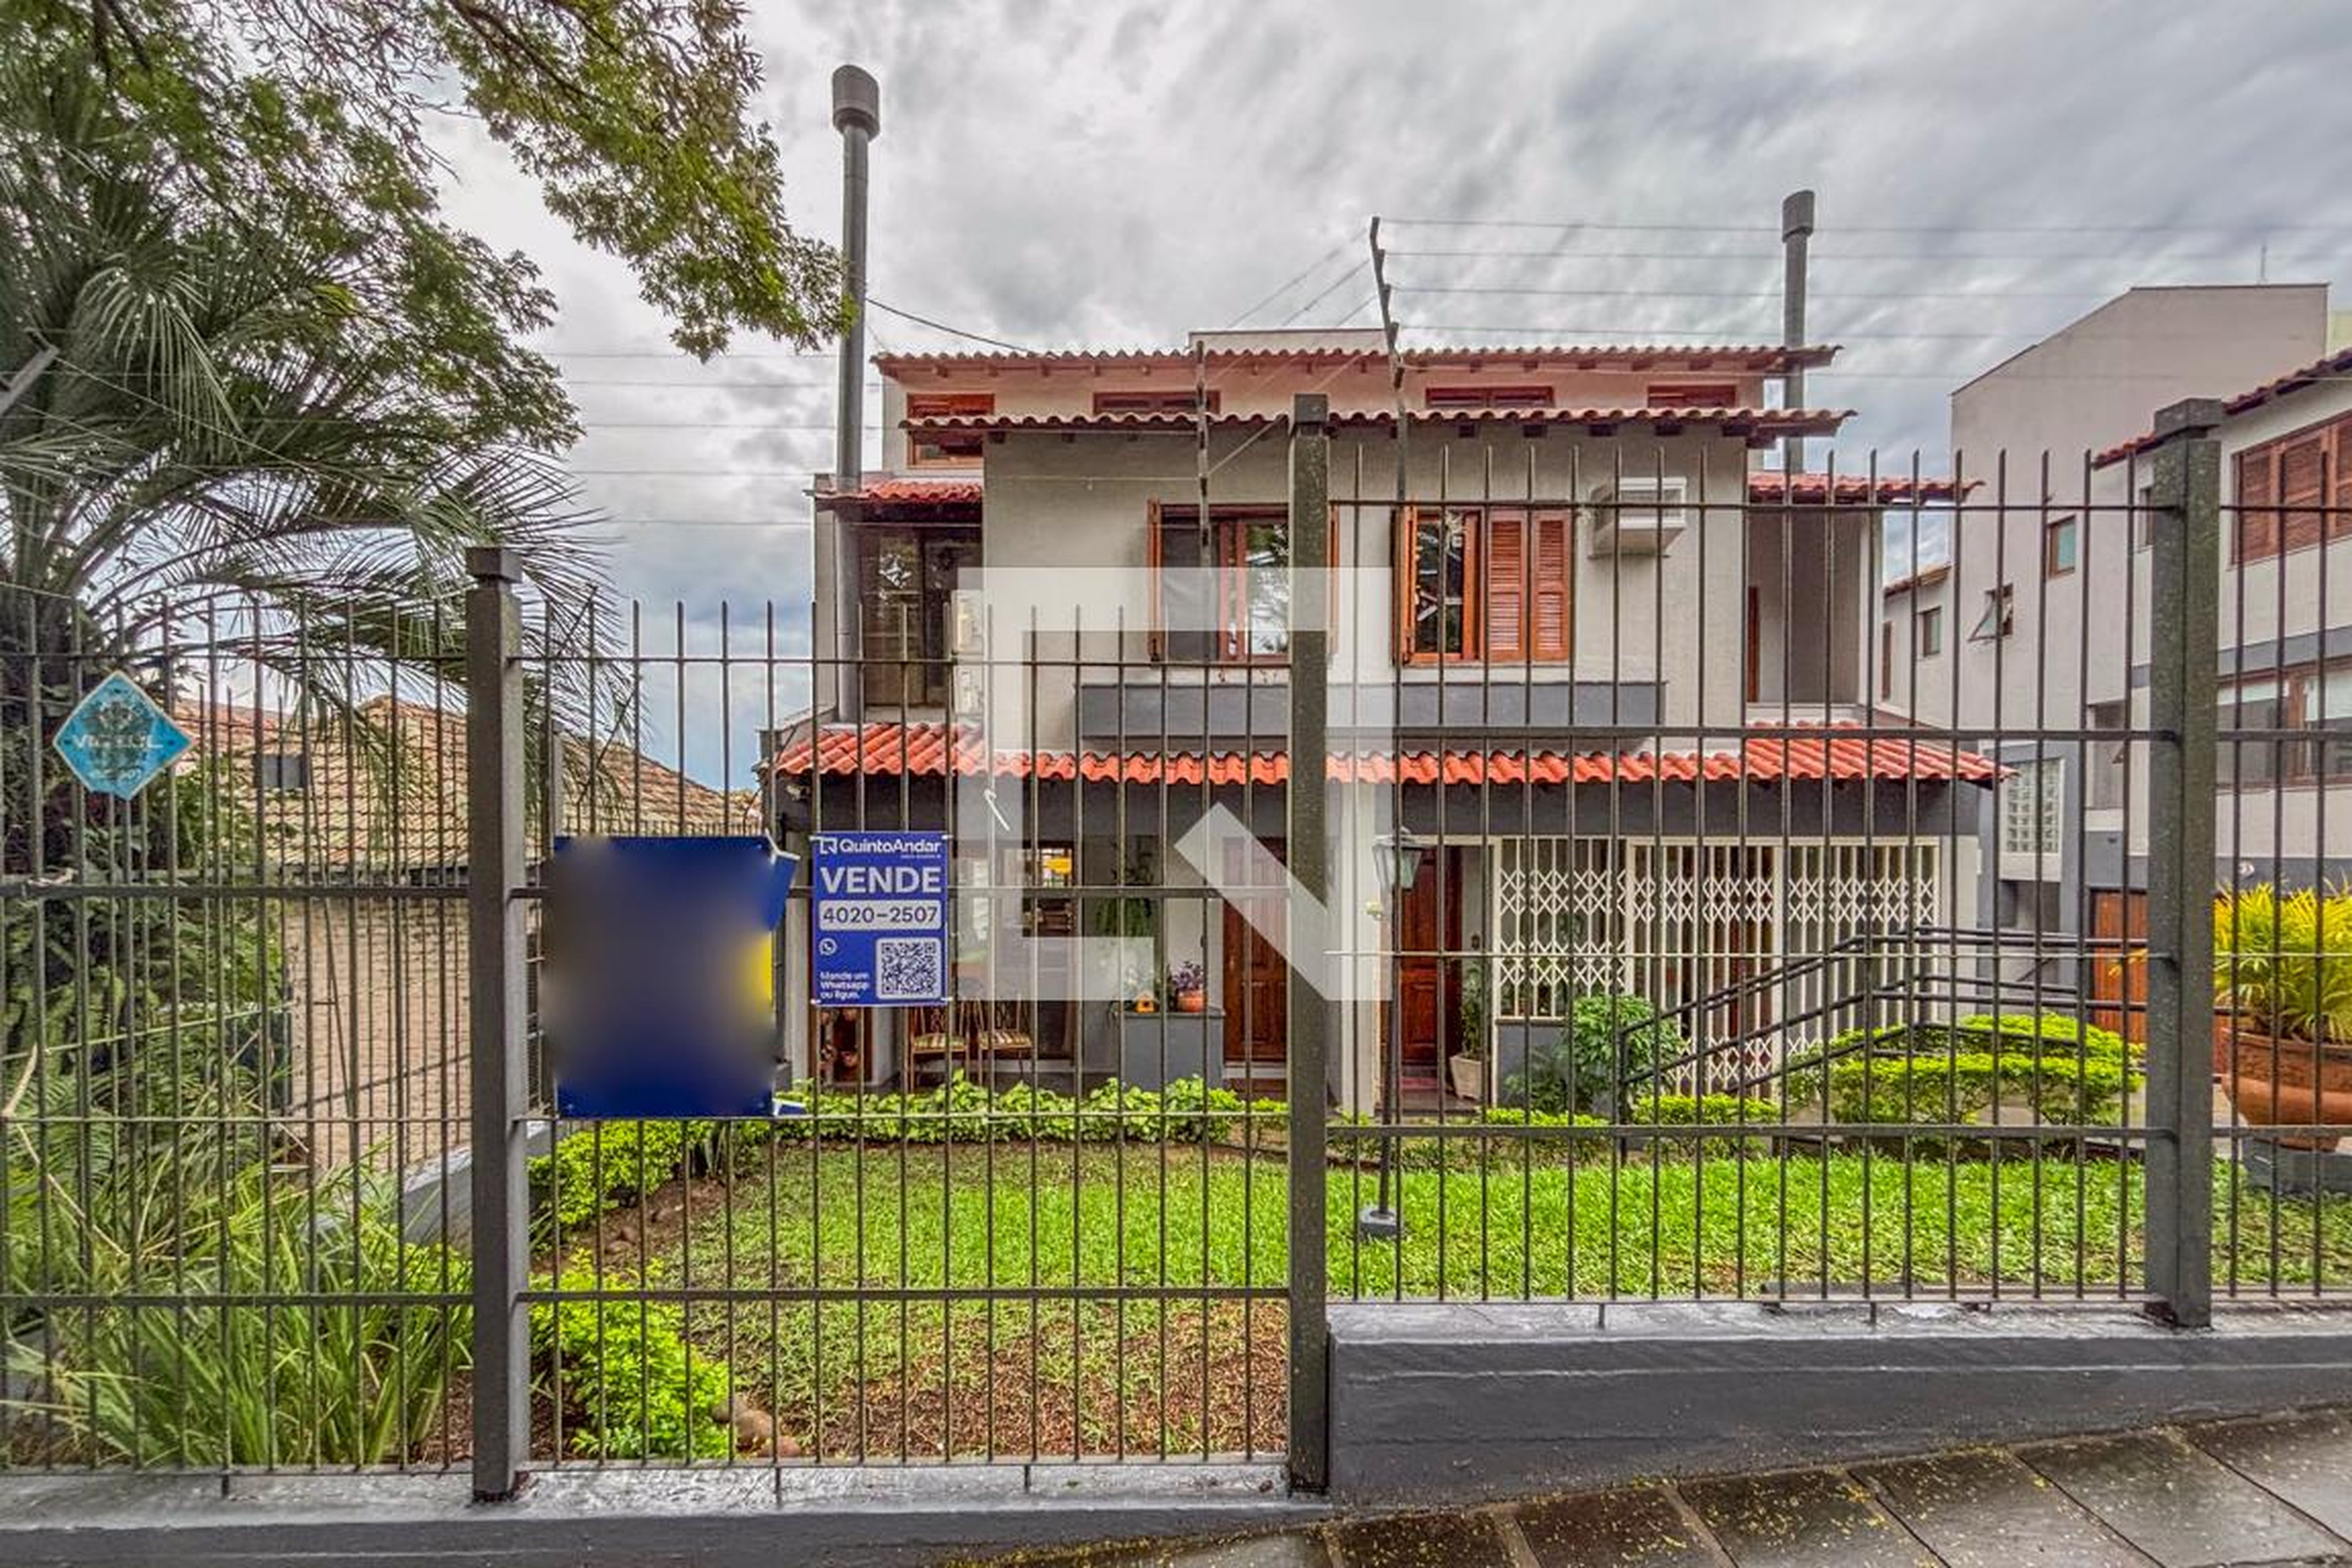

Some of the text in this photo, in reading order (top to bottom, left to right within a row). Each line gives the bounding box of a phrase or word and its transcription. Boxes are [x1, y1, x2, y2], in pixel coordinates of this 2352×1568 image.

[840, 839, 941, 853] QuintoAndar
[820, 867, 941, 894] VENDE
[823, 907, 938, 923] 4020-2507
